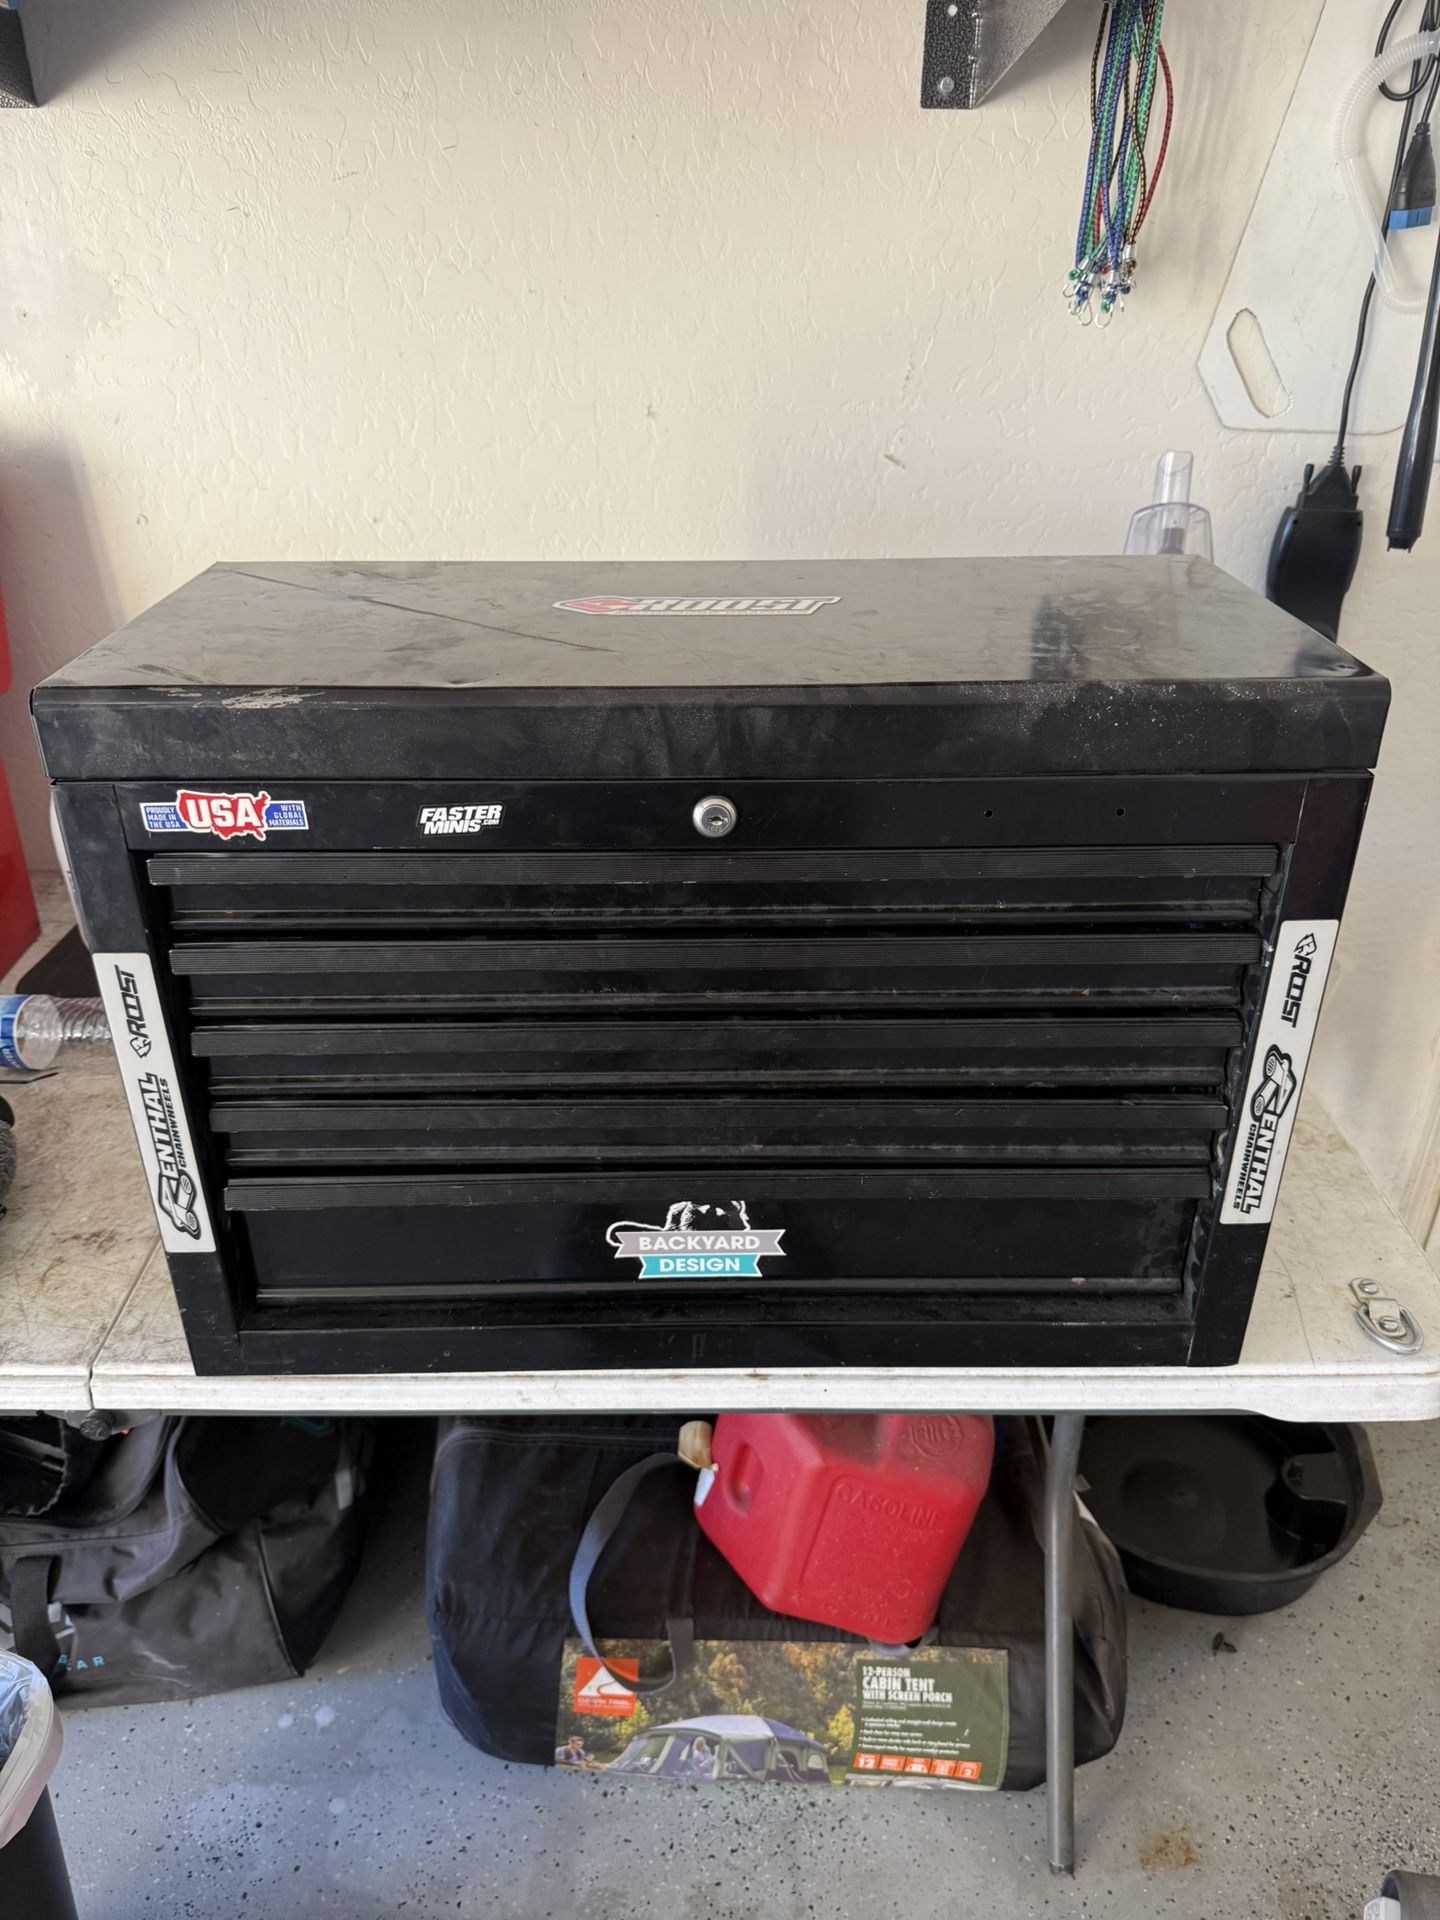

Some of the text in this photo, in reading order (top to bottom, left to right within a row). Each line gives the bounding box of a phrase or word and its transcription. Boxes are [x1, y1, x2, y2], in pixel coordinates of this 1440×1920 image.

[145, 806, 175, 814] PROUDLY
[185, 798, 262, 828] USA
[280, 804, 302, 812] WITH
[420, 804, 503, 824] FASTER
[147, 813, 177, 821] MADE IN
[159, 1077, 188, 1168] CHAINWHEELS
[1232, 1122, 1258, 1210] CHAINWHEELS
[638, 1235, 761, 1251] BACKYARD
[659, 1257, 741, 1273] DESIGN
[862, 1665, 911, 1678] 12-PERSON
[862, 1676, 935, 1692] CABIN TENT
[862, 1689, 953, 1704] WITH SCREEN PORCH
